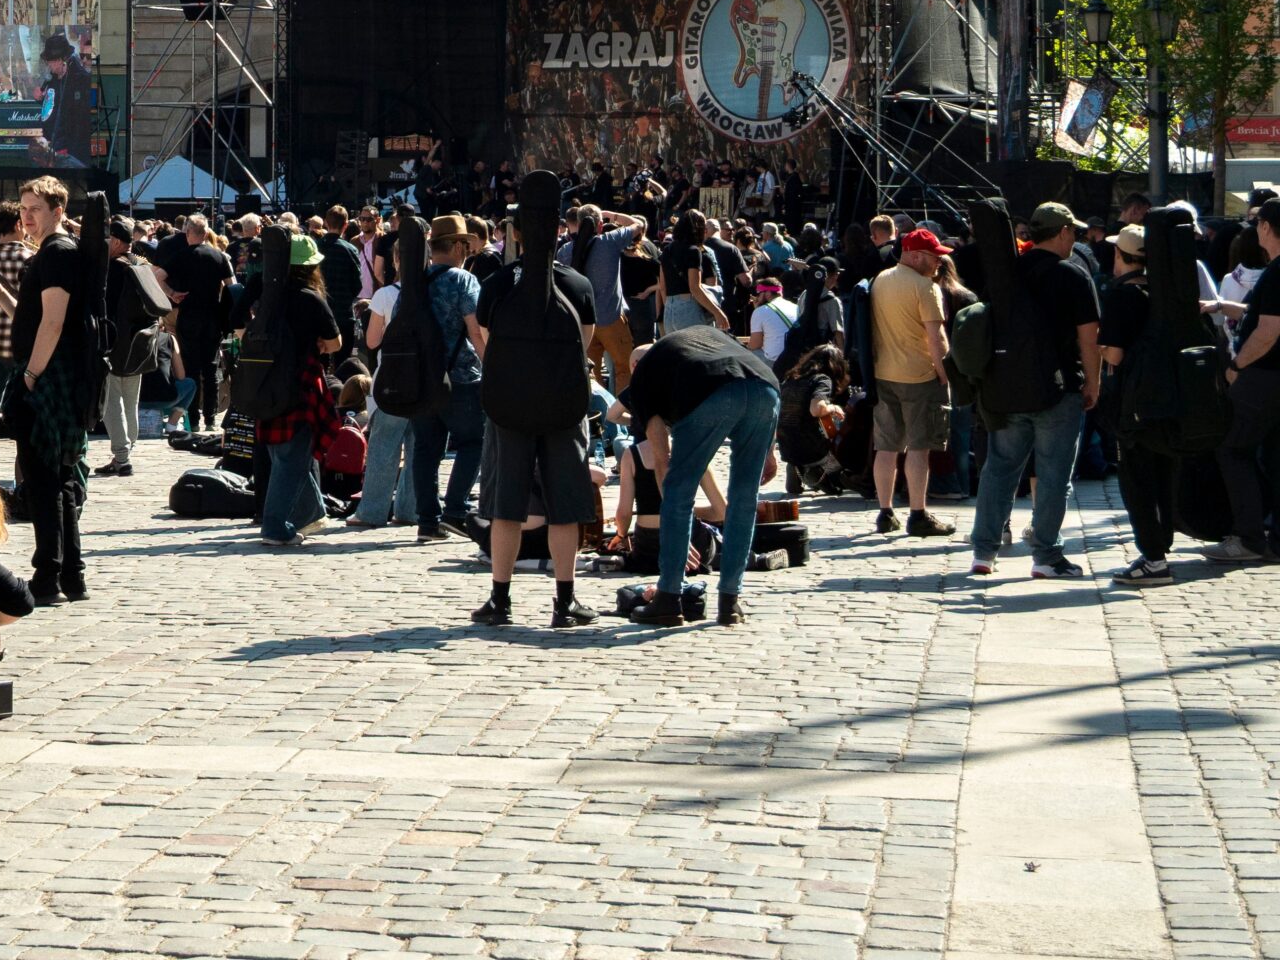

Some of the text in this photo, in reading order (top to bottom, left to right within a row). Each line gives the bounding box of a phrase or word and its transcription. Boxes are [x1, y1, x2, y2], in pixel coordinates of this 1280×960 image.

[542, 30, 676, 69] ZAGRAJ
[8, 111, 41, 122] Marshall
[696, 91, 784, 140] WROCŁAW
[1237, 126, 1269, 135] Bracia
